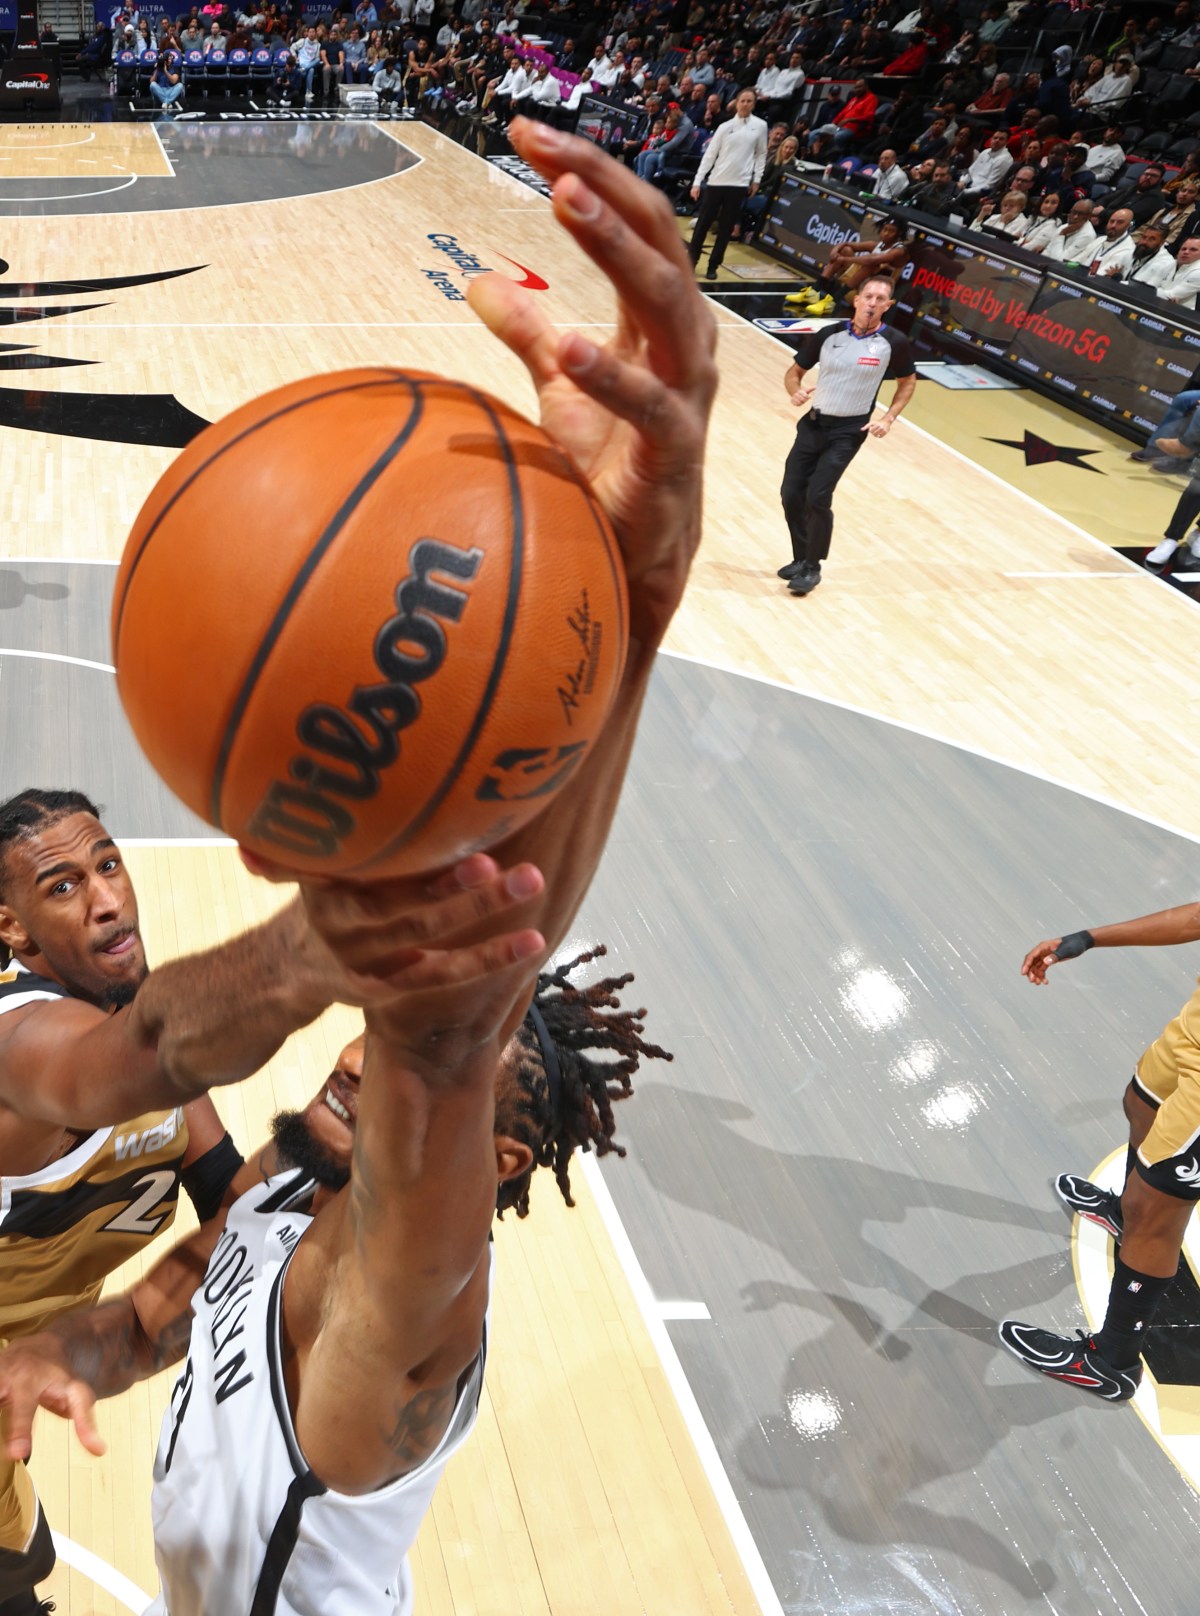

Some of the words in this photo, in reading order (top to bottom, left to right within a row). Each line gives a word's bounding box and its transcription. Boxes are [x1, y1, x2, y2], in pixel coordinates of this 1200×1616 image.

[912, 266, 987, 310] powered
[980, 289, 1006, 323] by
[1004, 298, 1077, 349] Verizon
[1073, 328, 1111, 364] 5G
[246, 536, 486, 859] Wilson
